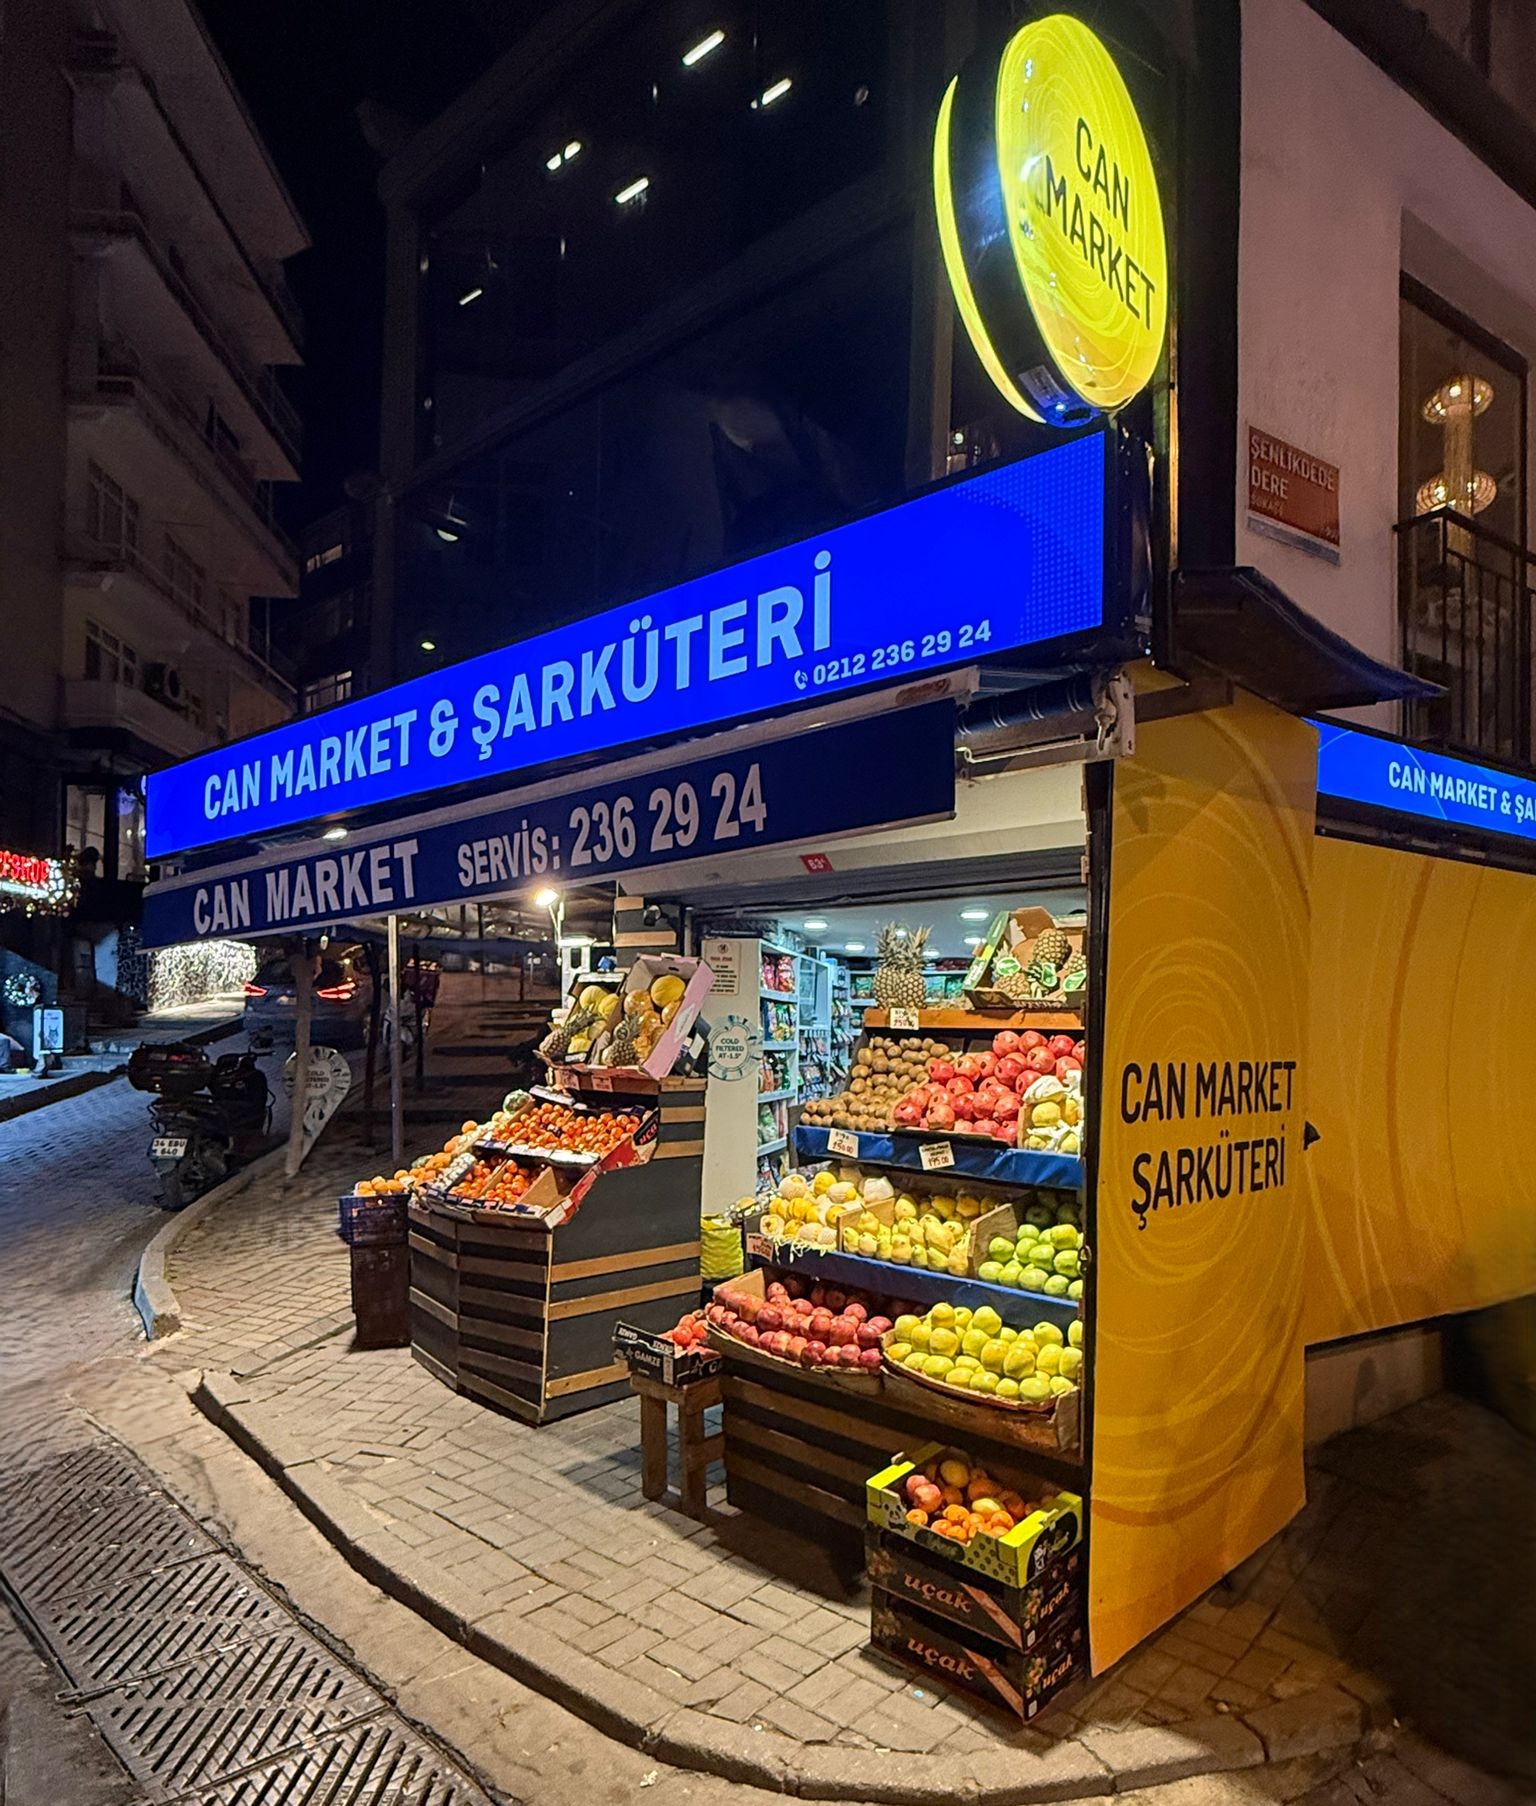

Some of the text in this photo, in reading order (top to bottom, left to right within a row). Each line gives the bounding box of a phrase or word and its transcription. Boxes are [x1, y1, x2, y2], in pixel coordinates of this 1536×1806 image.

[1076, 117, 1129, 232] CAN
[1046, 155, 1155, 330] MARKET
[1251, 465, 1289, 500] DERE
[813, 619, 992, 685] 0212 236 29 24
[203, 549, 832, 820] CAN MARKET & ŞARKÜTERİ
[1388, 761, 1536, 824] CAN MARKET & ŞA
[193, 763, 768, 935] CAN MARKET SERVİS: 236 29 24
[720, 1037, 740, 1045] COLD
[1121, 1061, 1296, 1125] CAN MARKET
[1131, 1123, 1285, 1231] ŞARKÜTERİ
[634, 1350, 661, 1368] GAMZE
[903, 1572, 972, 1614] uçak
[1039, 1581, 1070, 1620] uçak
[906, 1637, 974, 1681] uçak
[1042, 1653, 1073, 1690] uçak
